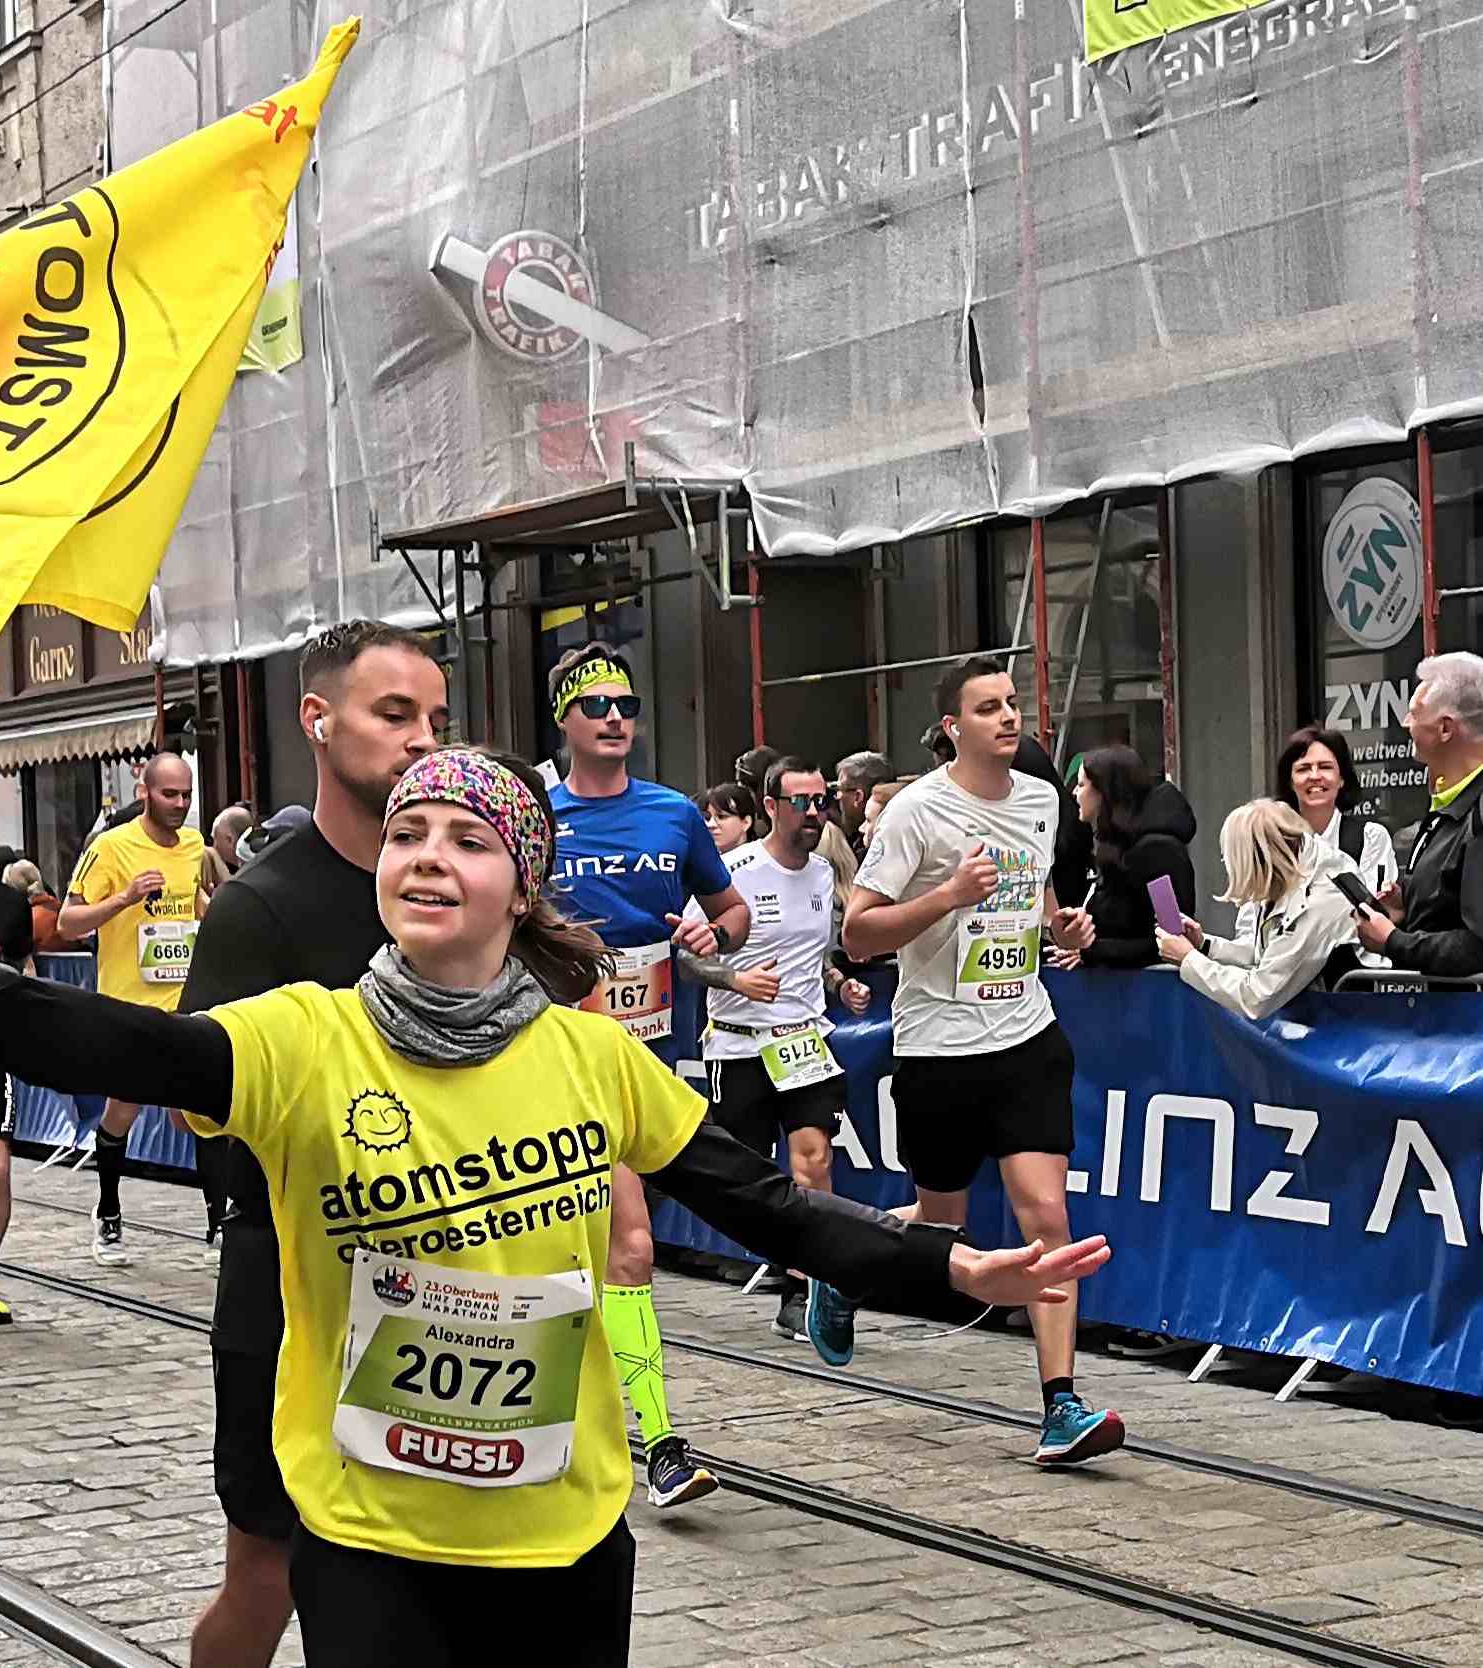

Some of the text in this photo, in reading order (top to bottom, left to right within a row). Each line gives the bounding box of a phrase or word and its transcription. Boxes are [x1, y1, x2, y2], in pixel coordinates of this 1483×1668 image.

[500, 240, 587, 289] TABAK
[486, 286, 568, 353] TRAFIK
[1337, 512, 1408, 632] ZYN
[29, 636, 74, 684] Garne
[1324, 679, 1410, 732] ZYN
[633, 853, 677, 873] AG
[977, 946, 1027, 970] 4950
[605, 983, 649, 1010] 167
[778, 1038, 821, 1064] 2715
[320, 1119, 607, 1221] atomstopp
[424, 1280, 502, 1302] 23.Oberbank
[455, 1296, 500, 1312] DONAU
[421, 1302, 499, 1322] MARATHON
[425, 1323, 516, 1350] Alexandra
[391, 1343, 537, 1407] 2072
[399, 1426, 514, 1473] FUSSL
